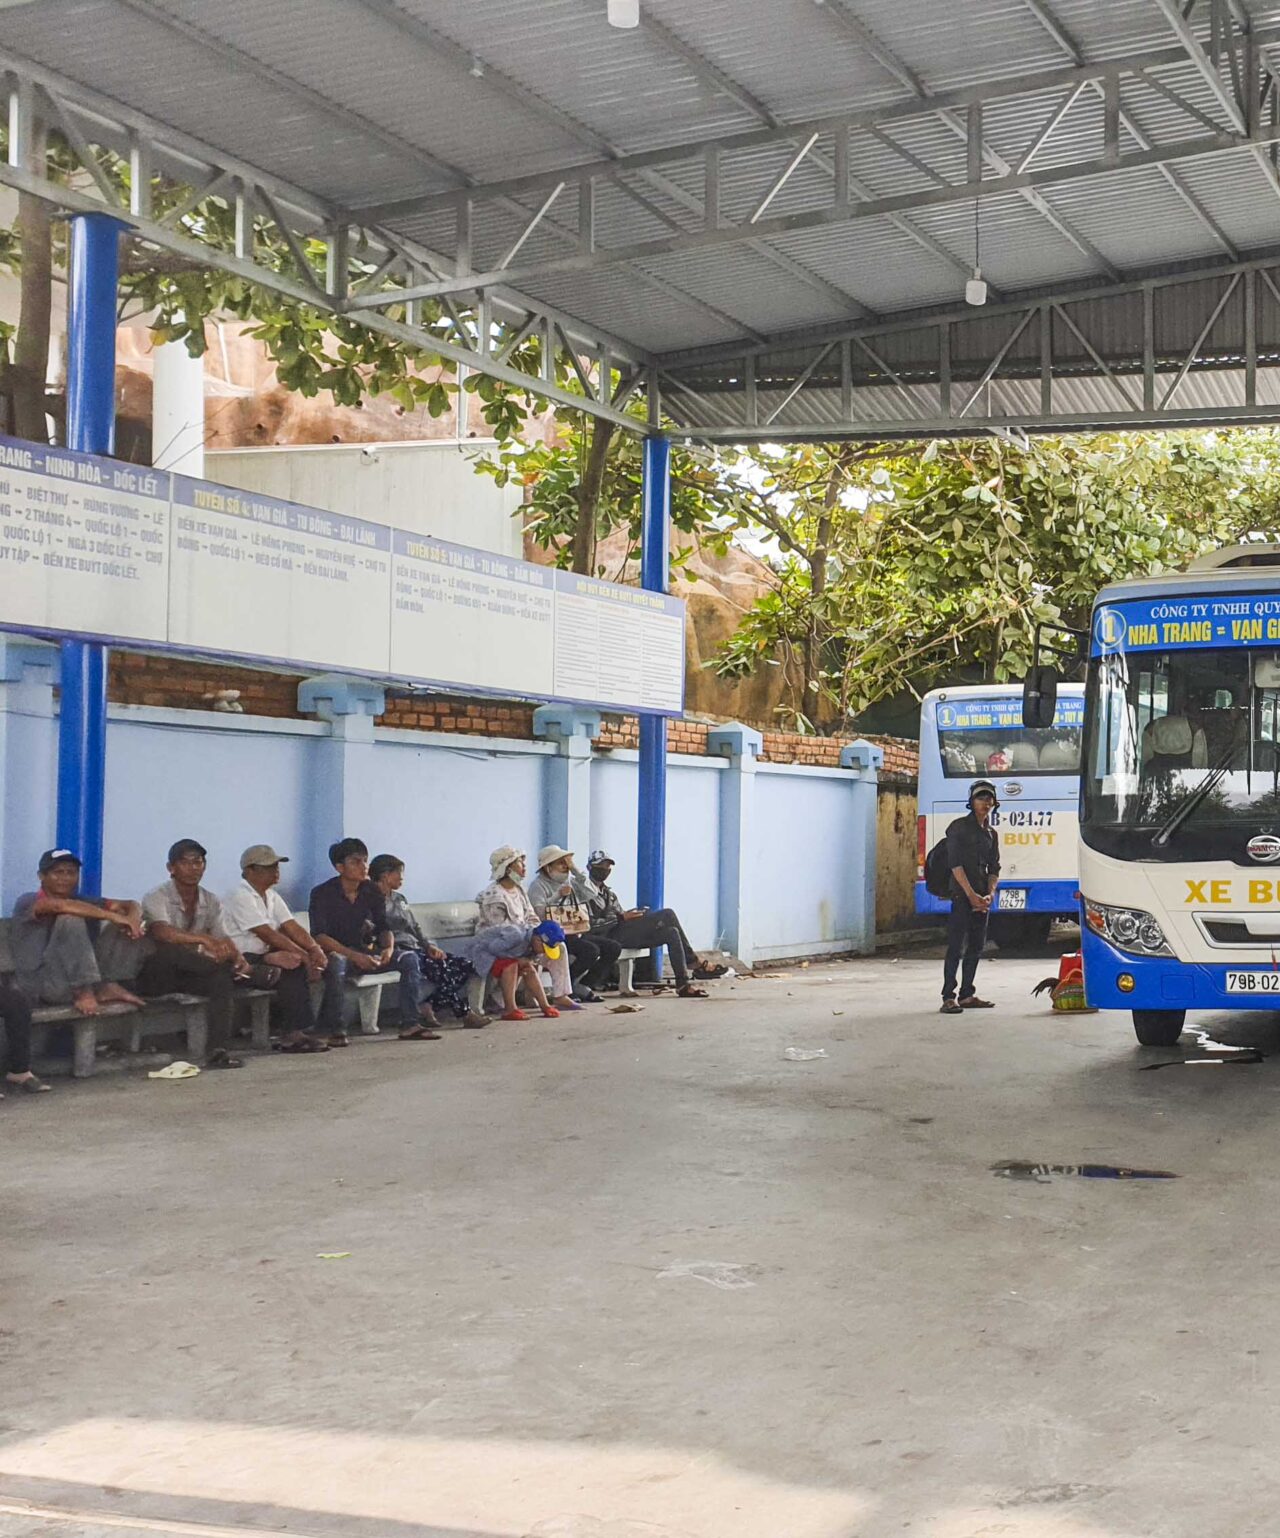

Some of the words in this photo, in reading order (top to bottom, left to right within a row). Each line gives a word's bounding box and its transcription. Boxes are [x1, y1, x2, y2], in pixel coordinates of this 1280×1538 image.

[46, 456, 74, 478] NINH
[78, 461, 101, 484] HÒA
[114, 469, 136, 491] DỐC
[138, 473, 157, 496] LẾT
[1151, 604, 1188, 619] CÔNG
[1191, 605, 1208, 616] TY
[1212, 603, 1250, 615] TNHH
[1104, 616, 1115, 643] 1
[1128, 623, 1158, 646] NHA
[1163, 621, 1212, 643] TRANG
[1232, 619, 1262, 644] VẠN
[941, 709, 952, 725] 1
[956, 714, 969, 727] NHA
[971, 714, 992, 725] TRANG
[1184, 879, 1232, 903] XE
